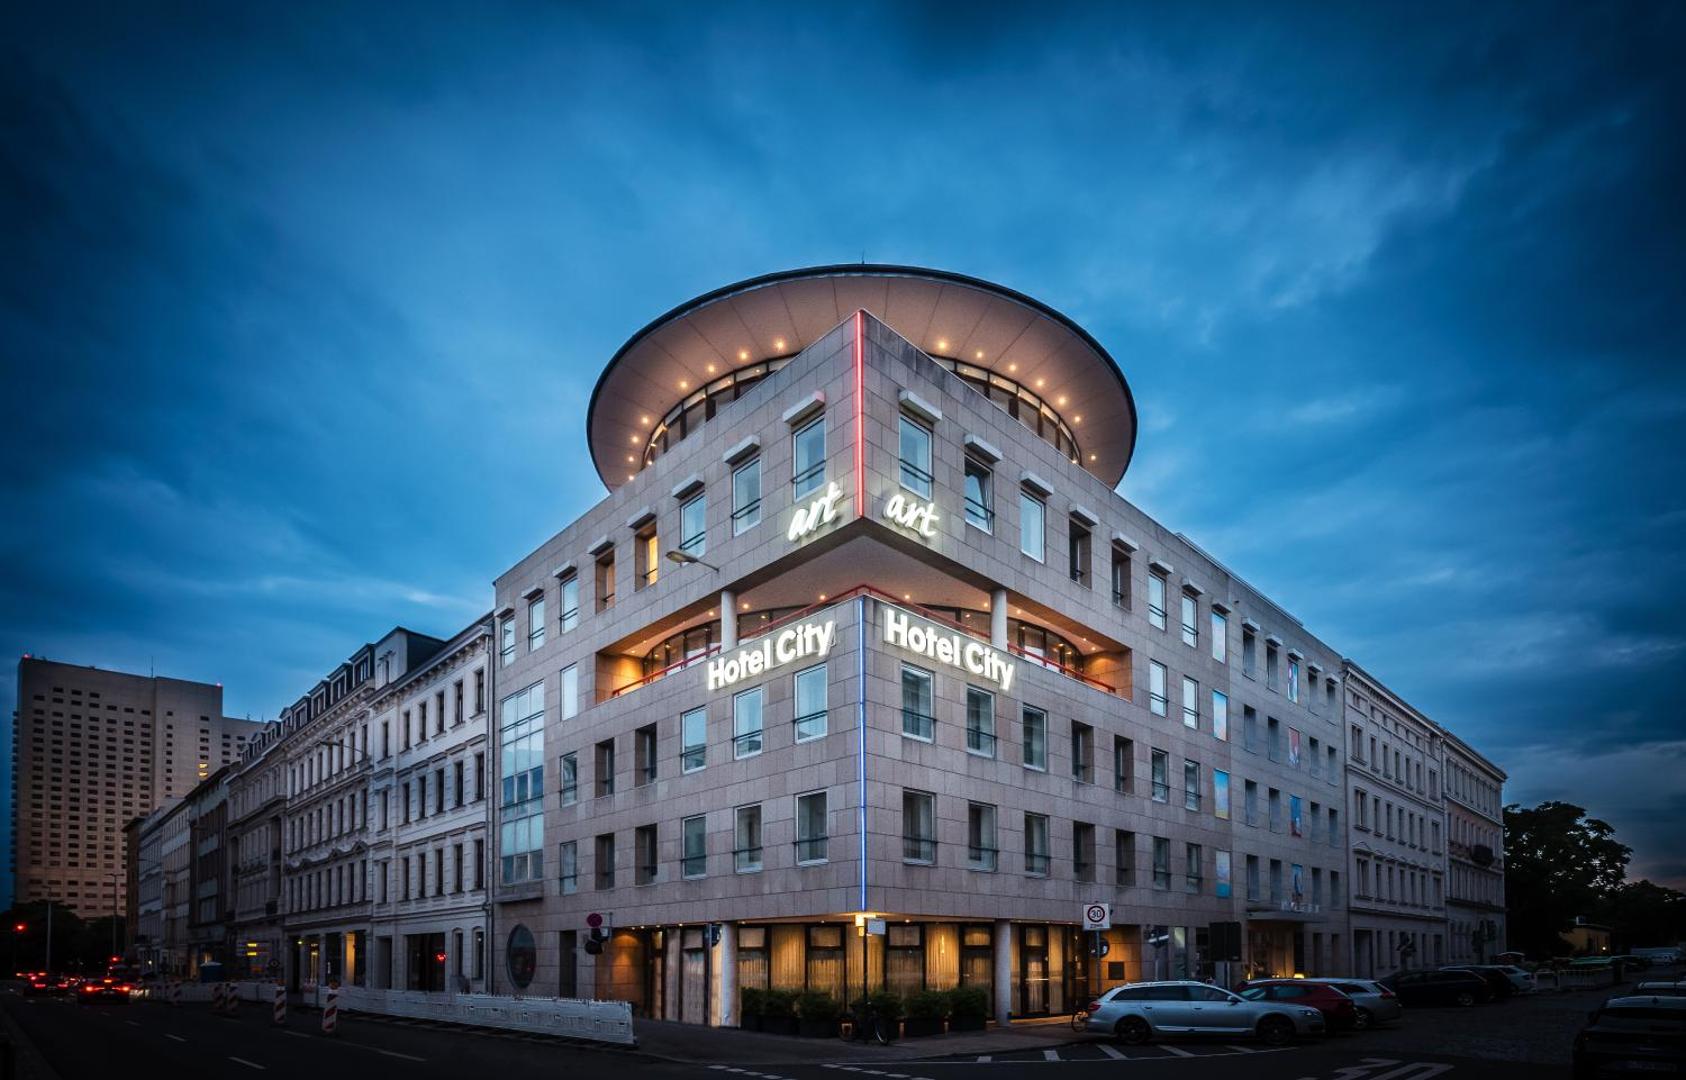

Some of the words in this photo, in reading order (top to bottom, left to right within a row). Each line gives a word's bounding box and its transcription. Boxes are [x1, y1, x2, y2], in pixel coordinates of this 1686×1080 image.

[788, 481, 841, 541] art
[883, 494, 940, 537] art
[707, 638, 771, 690] Hotel
[776, 620, 835, 662] City
[884, 608, 961, 666] Hotel
[964, 642, 1014, 691] City
[1090, 909, 1102, 919] 30
